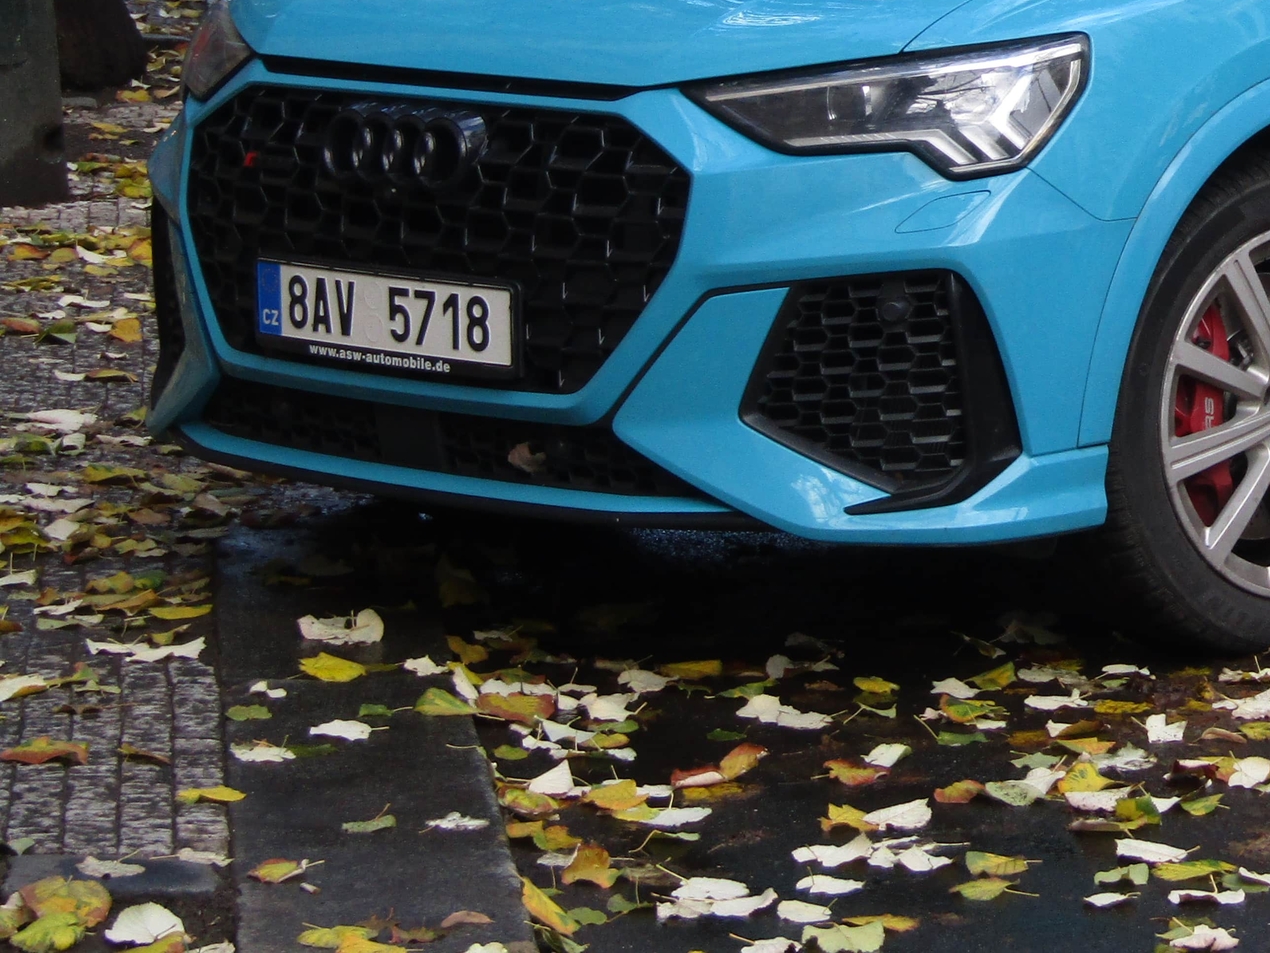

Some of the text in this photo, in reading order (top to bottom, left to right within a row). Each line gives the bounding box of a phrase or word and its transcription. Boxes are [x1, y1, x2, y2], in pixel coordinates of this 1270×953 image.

[262, 274, 490, 352] CZ 8AV 5718
[309, 344, 451, 373] www.asw-automobile.de
